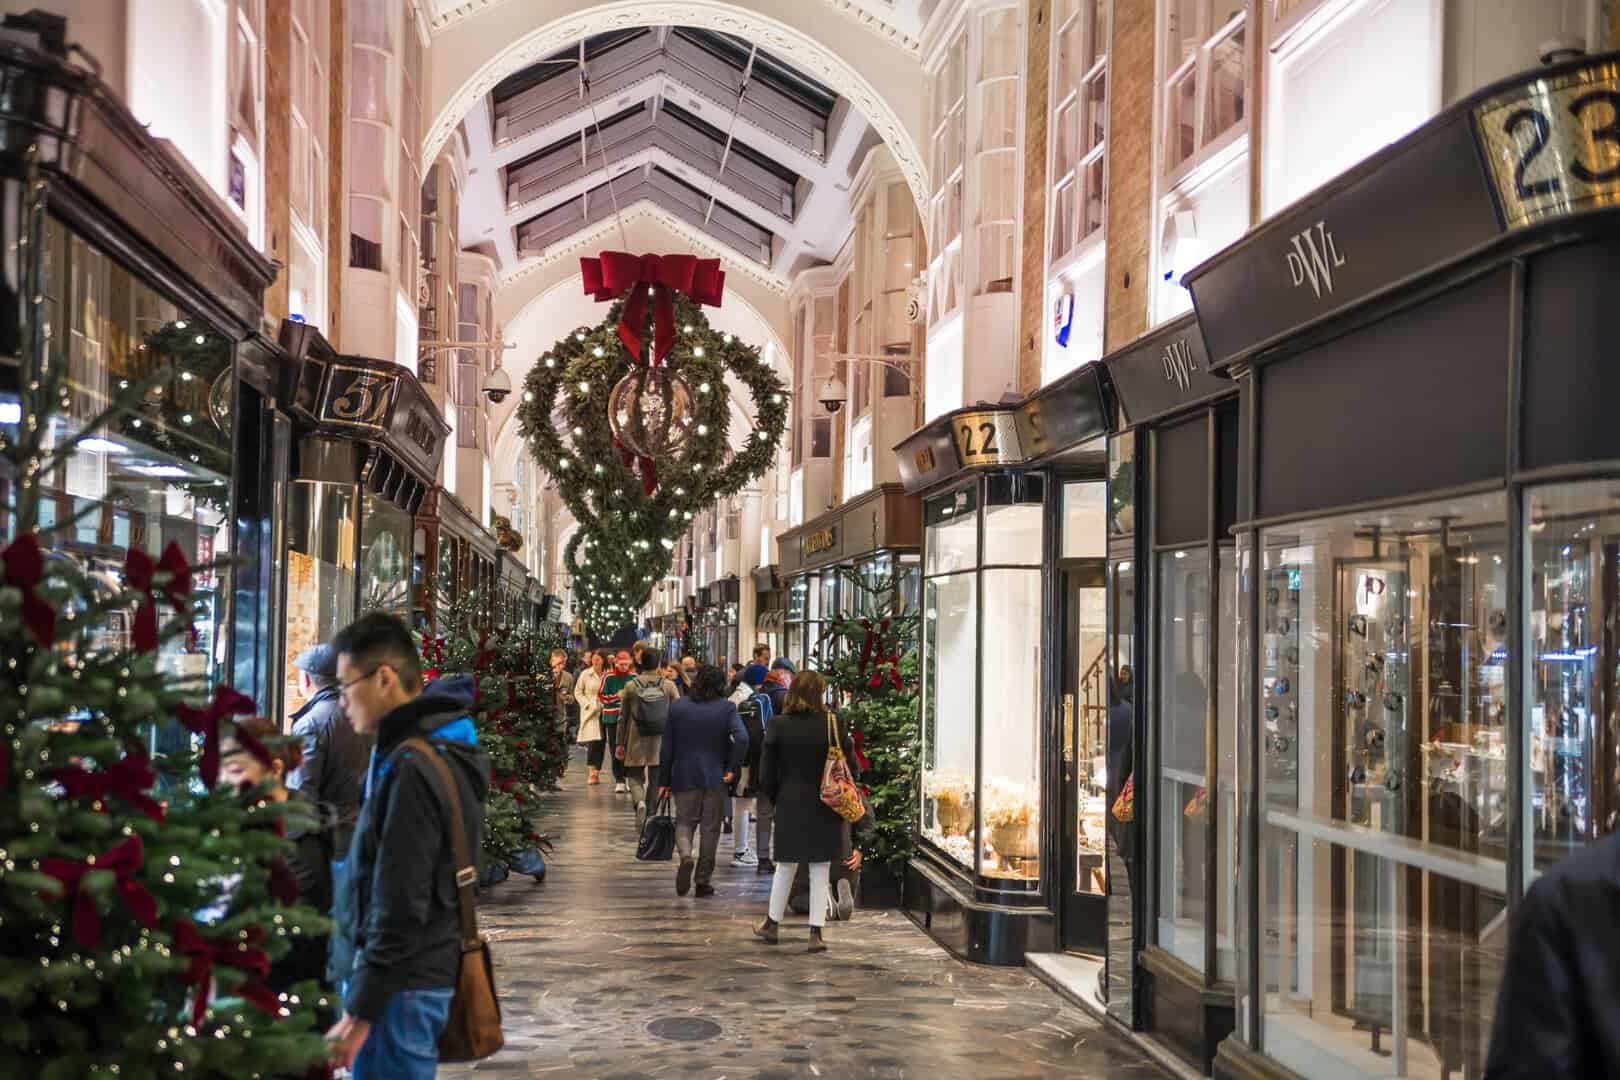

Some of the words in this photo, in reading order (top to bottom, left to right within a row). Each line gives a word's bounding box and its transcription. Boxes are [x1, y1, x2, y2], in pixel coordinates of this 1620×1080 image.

[1286, 220, 1345, 299] DWL
[1161, 339, 1199, 393] DWL
[332, 375, 394, 424] 51
[961, 422, 999, 457] 22
